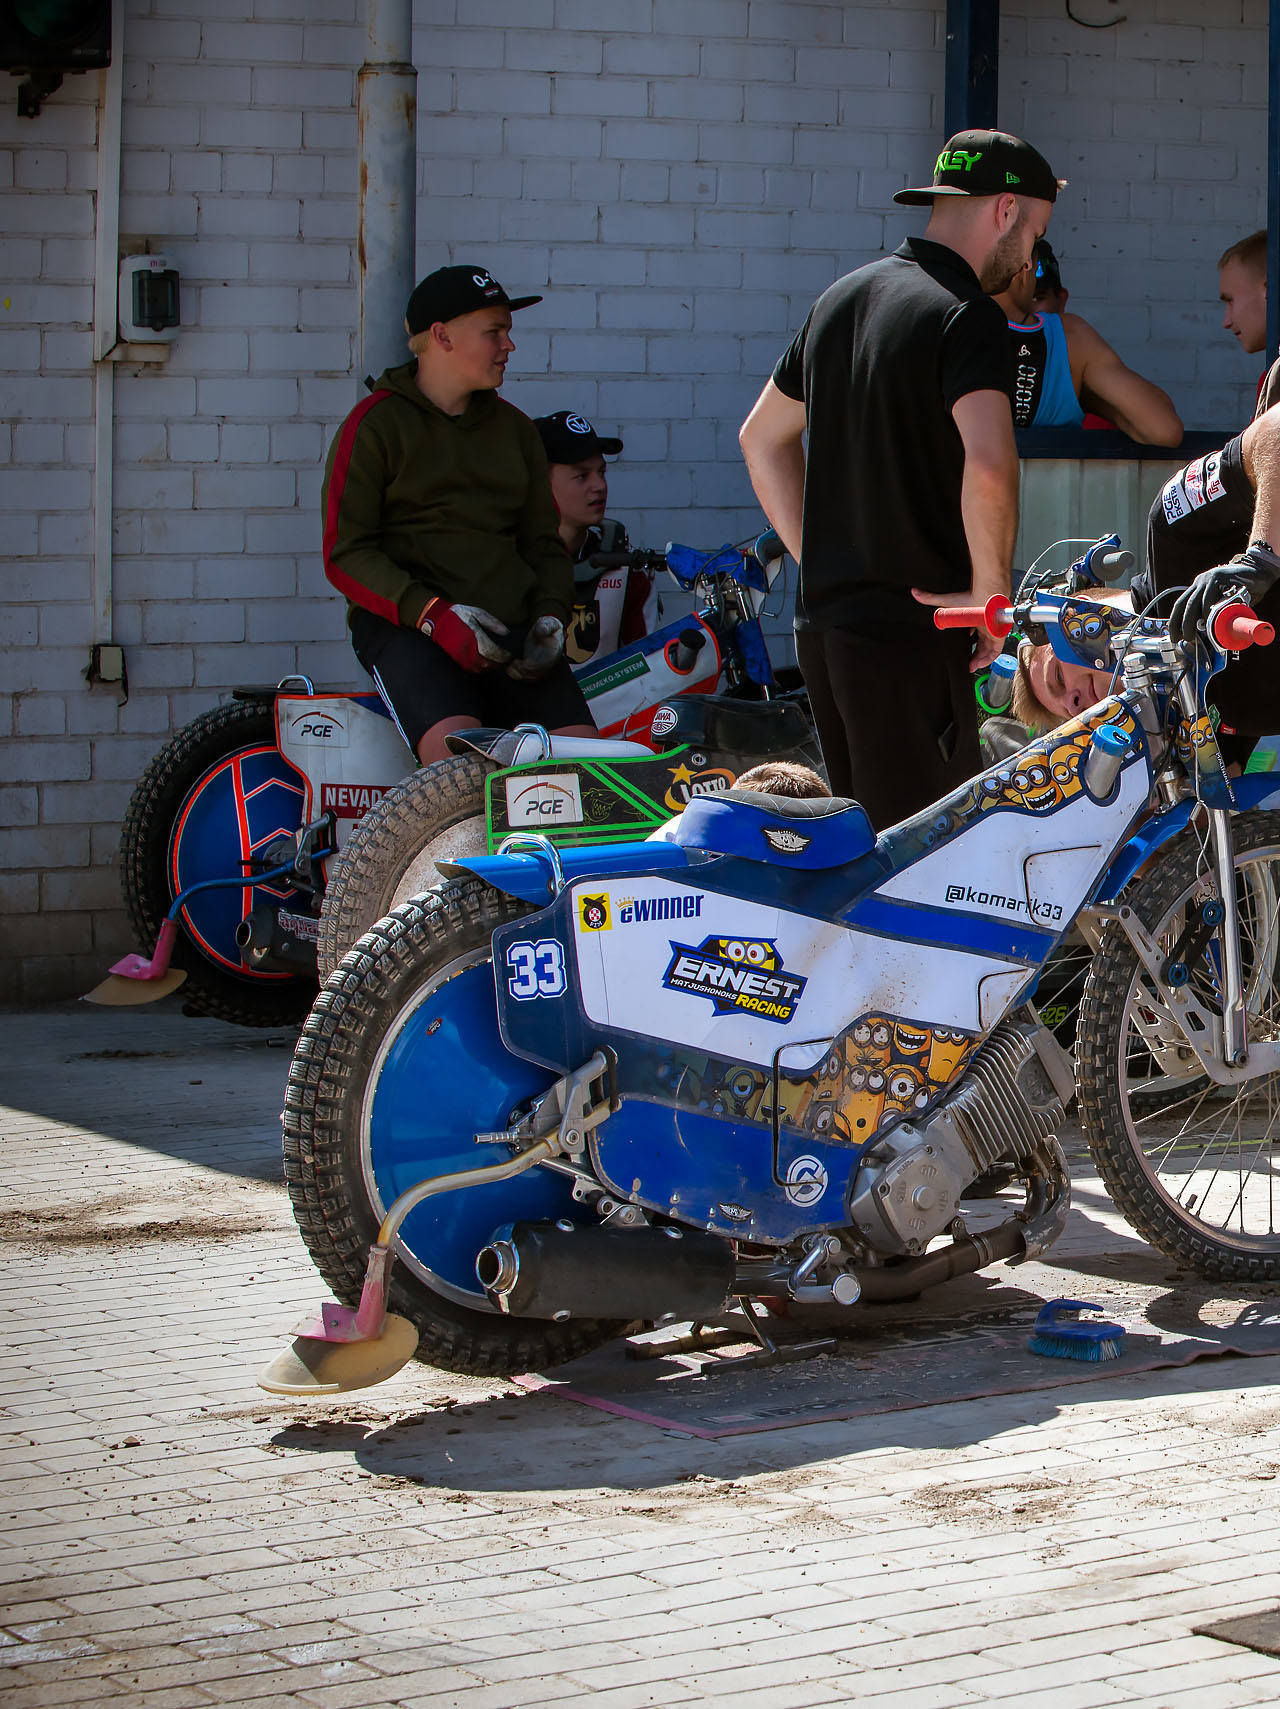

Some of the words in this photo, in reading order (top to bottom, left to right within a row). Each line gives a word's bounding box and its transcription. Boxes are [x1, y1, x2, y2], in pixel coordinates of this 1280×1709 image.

[301, 724, 333, 738] PGE
[525, 799, 564, 816] PGE
[508, 940, 566, 1000] 33
[673, 956, 800, 999] ERNEST
[670, 977, 738, 1000] MATJUSHONOKS
[736, 993, 792, 1019] RACING
